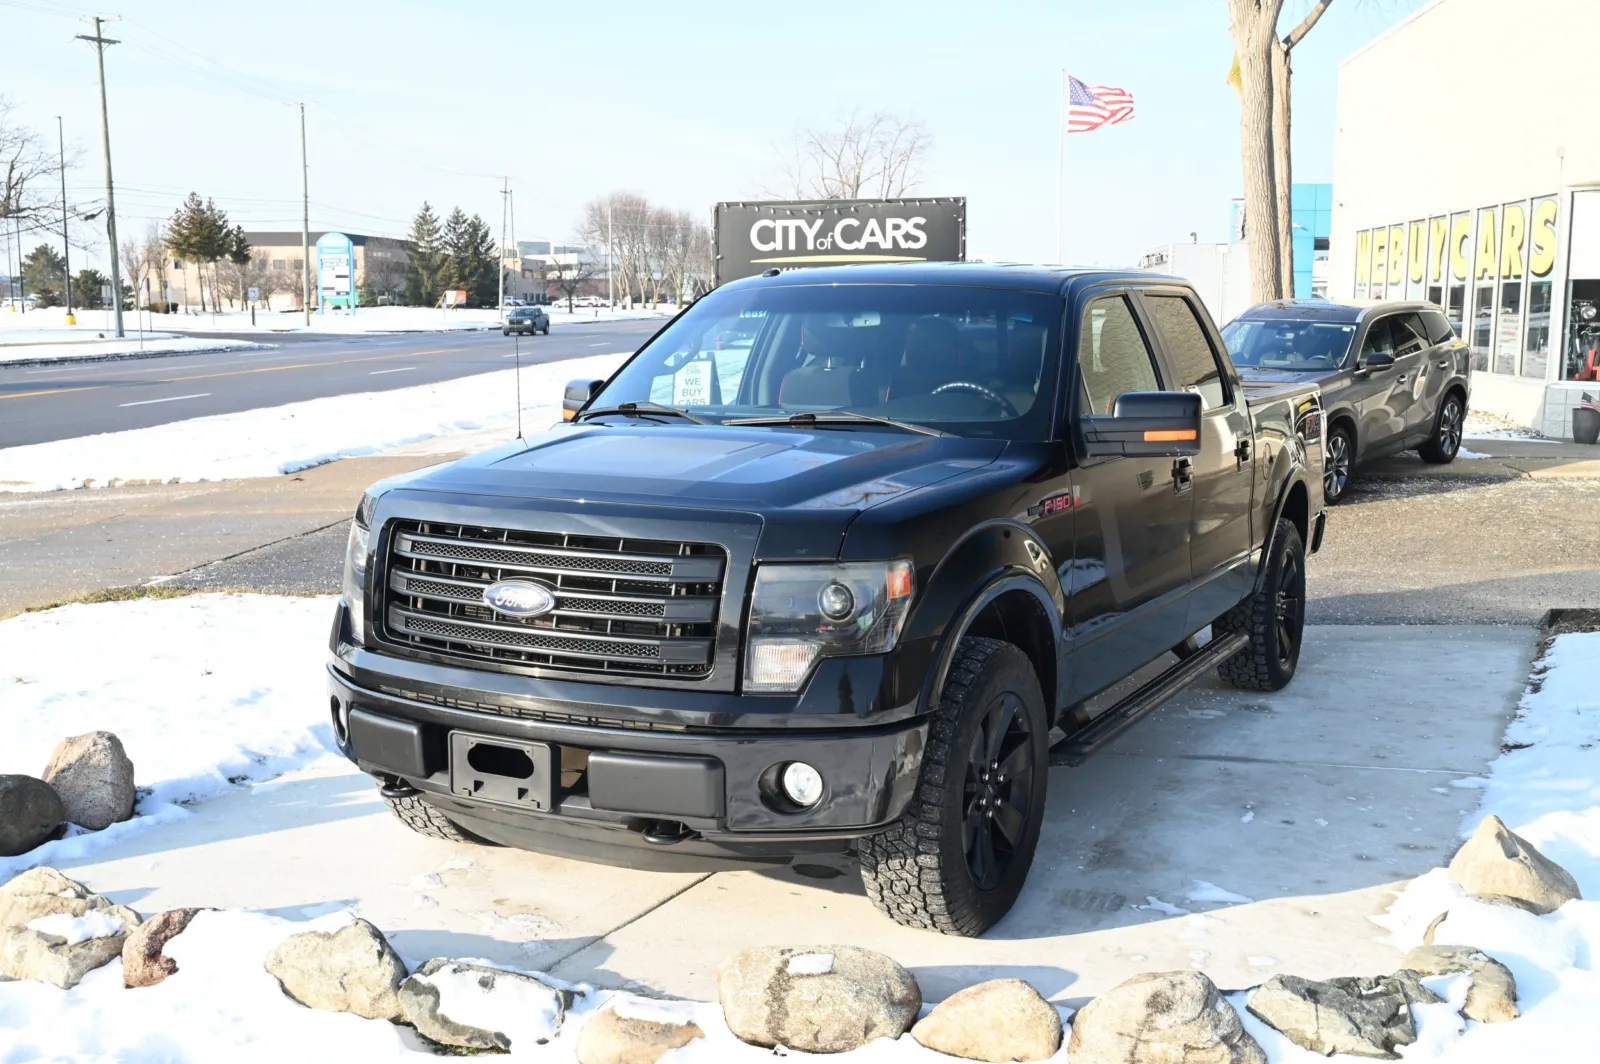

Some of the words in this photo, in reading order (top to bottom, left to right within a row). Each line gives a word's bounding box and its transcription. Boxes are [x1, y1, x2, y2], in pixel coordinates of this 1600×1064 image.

[750, 218, 824, 251] CITY
[817, 233, 833, 250] of
[834, 217, 927, 250] CARS
[685, 378, 700, 386] WE
[682, 388, 702, 397] BUY
